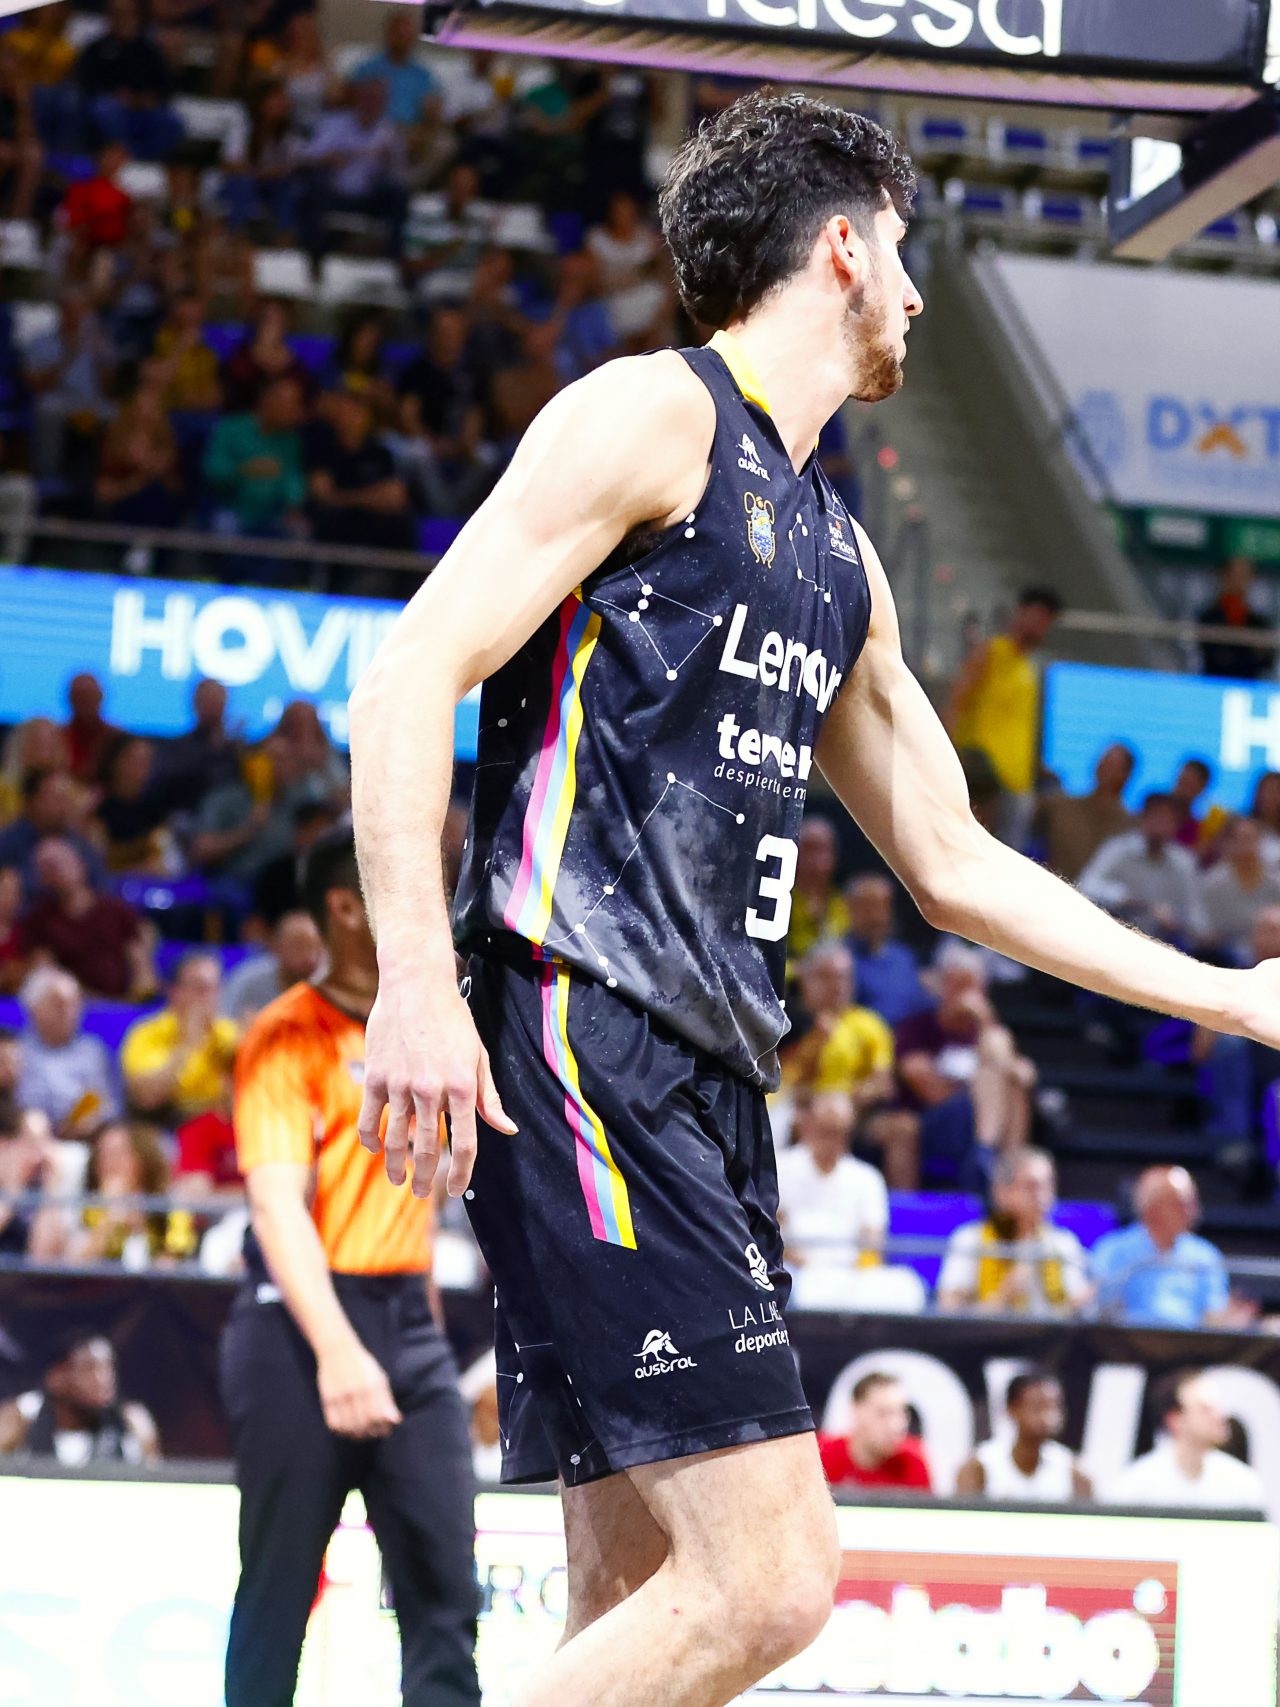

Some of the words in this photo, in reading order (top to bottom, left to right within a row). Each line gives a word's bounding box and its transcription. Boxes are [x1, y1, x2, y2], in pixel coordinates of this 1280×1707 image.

[577, 0, 1061, 57] esa
[110, 588, 402, 691] HOVI
[745, 833, 799, 942] 3
[728, 1306, 758, 1330] LA
[635, 1356, 698, 1379] austral
